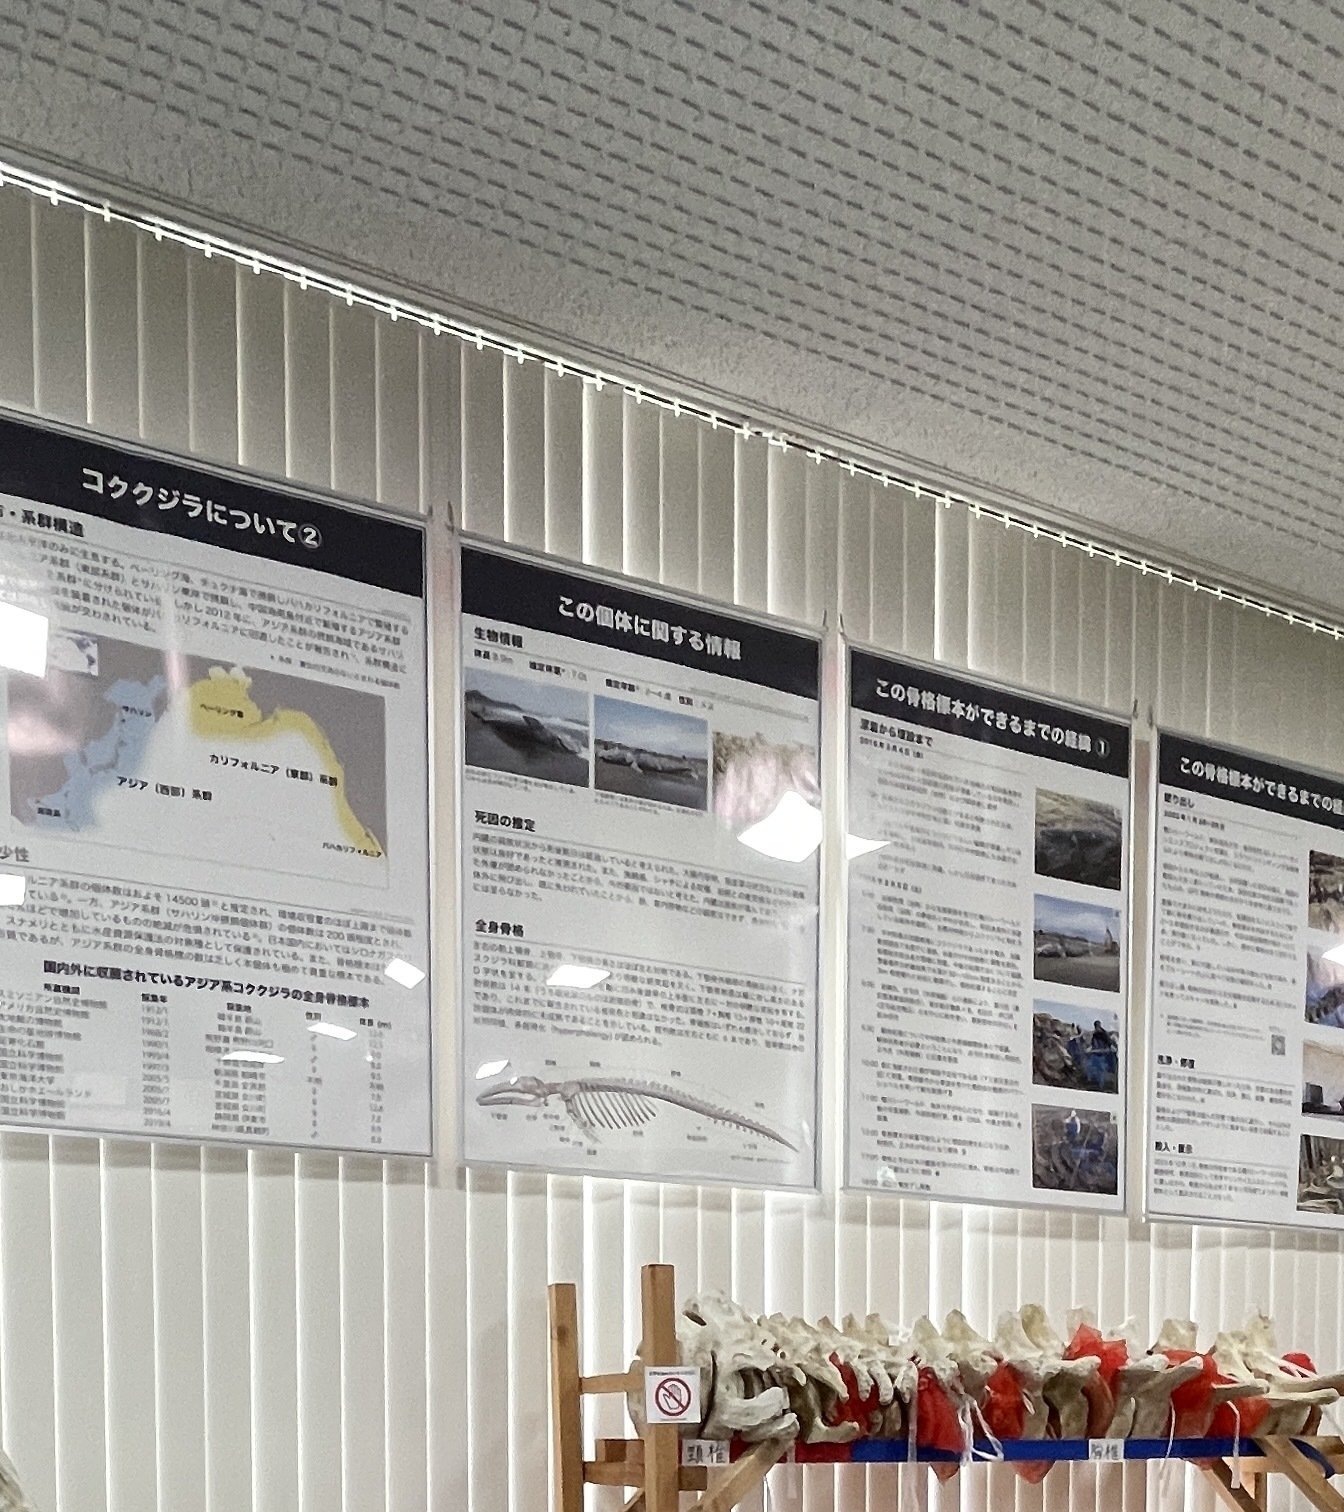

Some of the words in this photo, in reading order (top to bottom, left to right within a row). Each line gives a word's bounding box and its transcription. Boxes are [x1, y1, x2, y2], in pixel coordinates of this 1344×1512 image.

[81, 466, 322, 554] コククジラについて②
[558, 594, 741, 662] この個体に関する情報
[474, 809, 535, 833] 死因の推定
